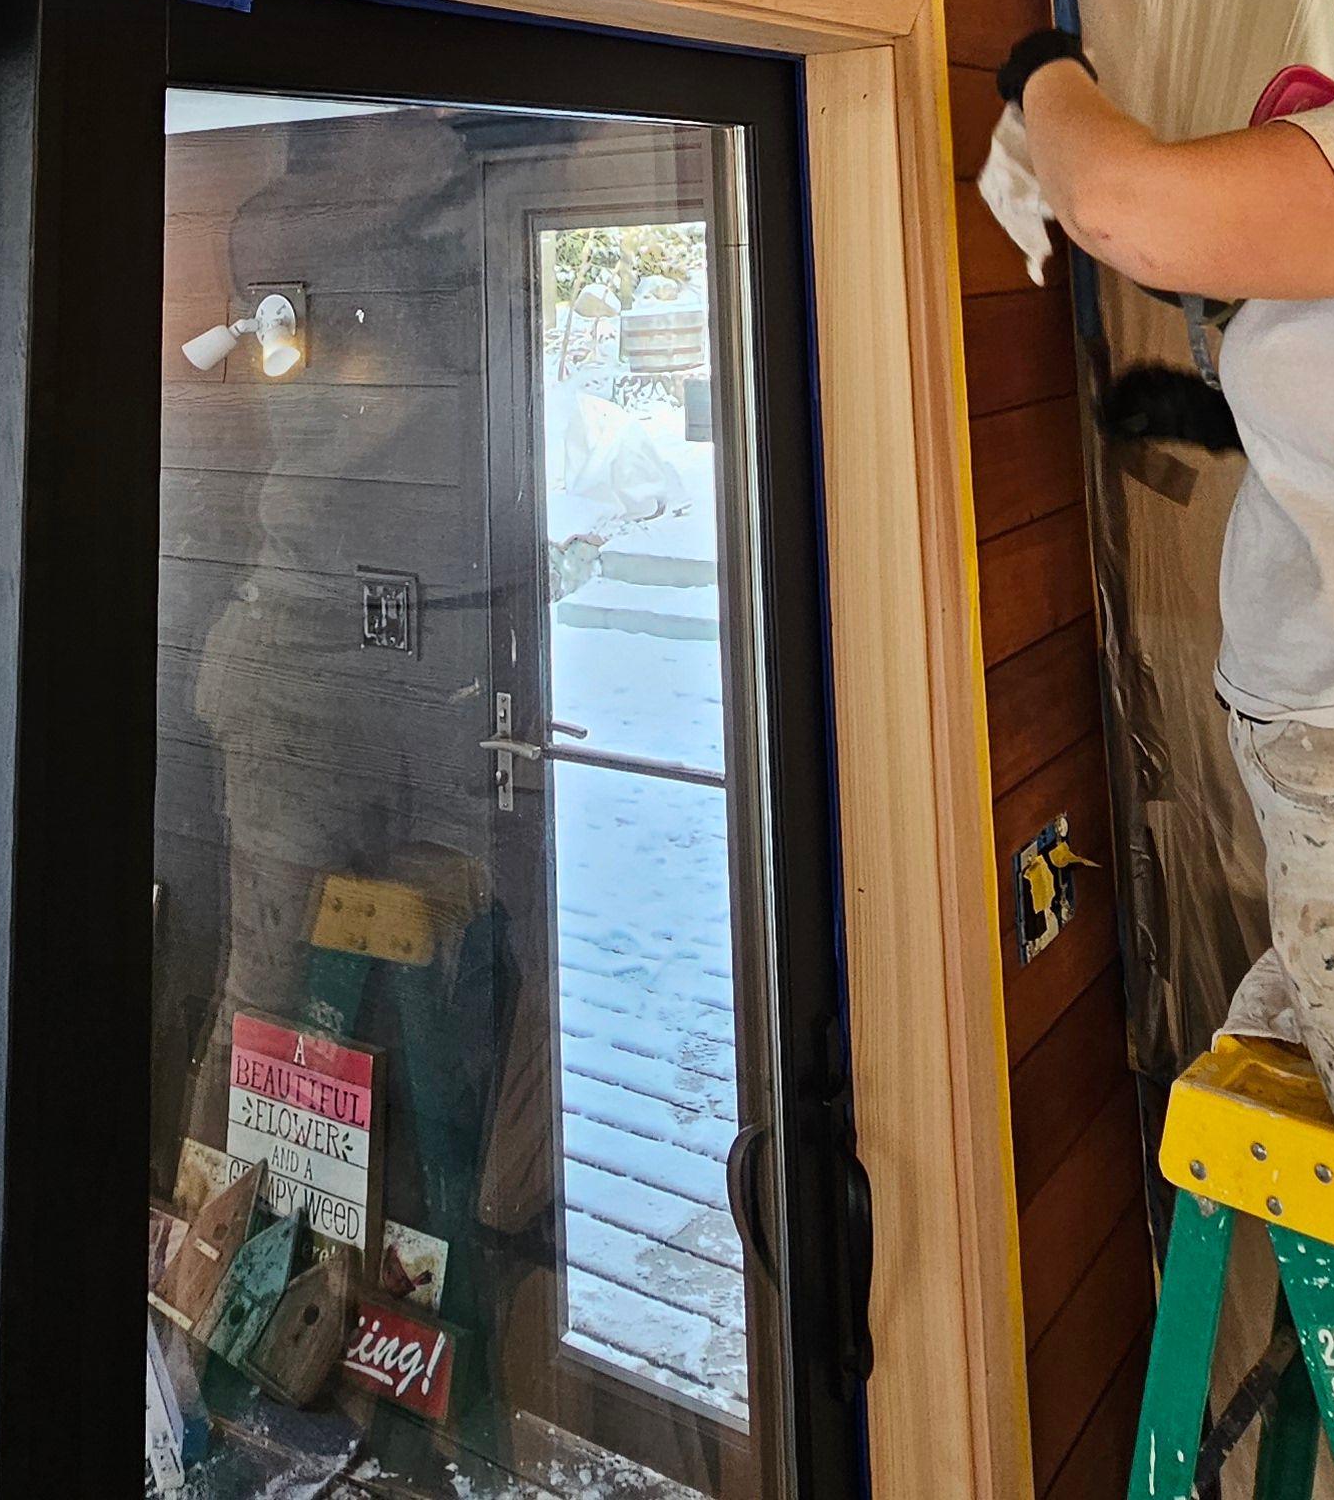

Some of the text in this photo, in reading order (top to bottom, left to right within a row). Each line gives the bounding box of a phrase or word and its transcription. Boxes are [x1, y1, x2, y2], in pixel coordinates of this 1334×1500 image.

[293, 1033, 307, 1067] A
[235, 1054, 365, 1127] BEAUTIFUL
[255, 1098, 341, 1159] FLOWER
[271, 1144, 313, 1181] AND A
